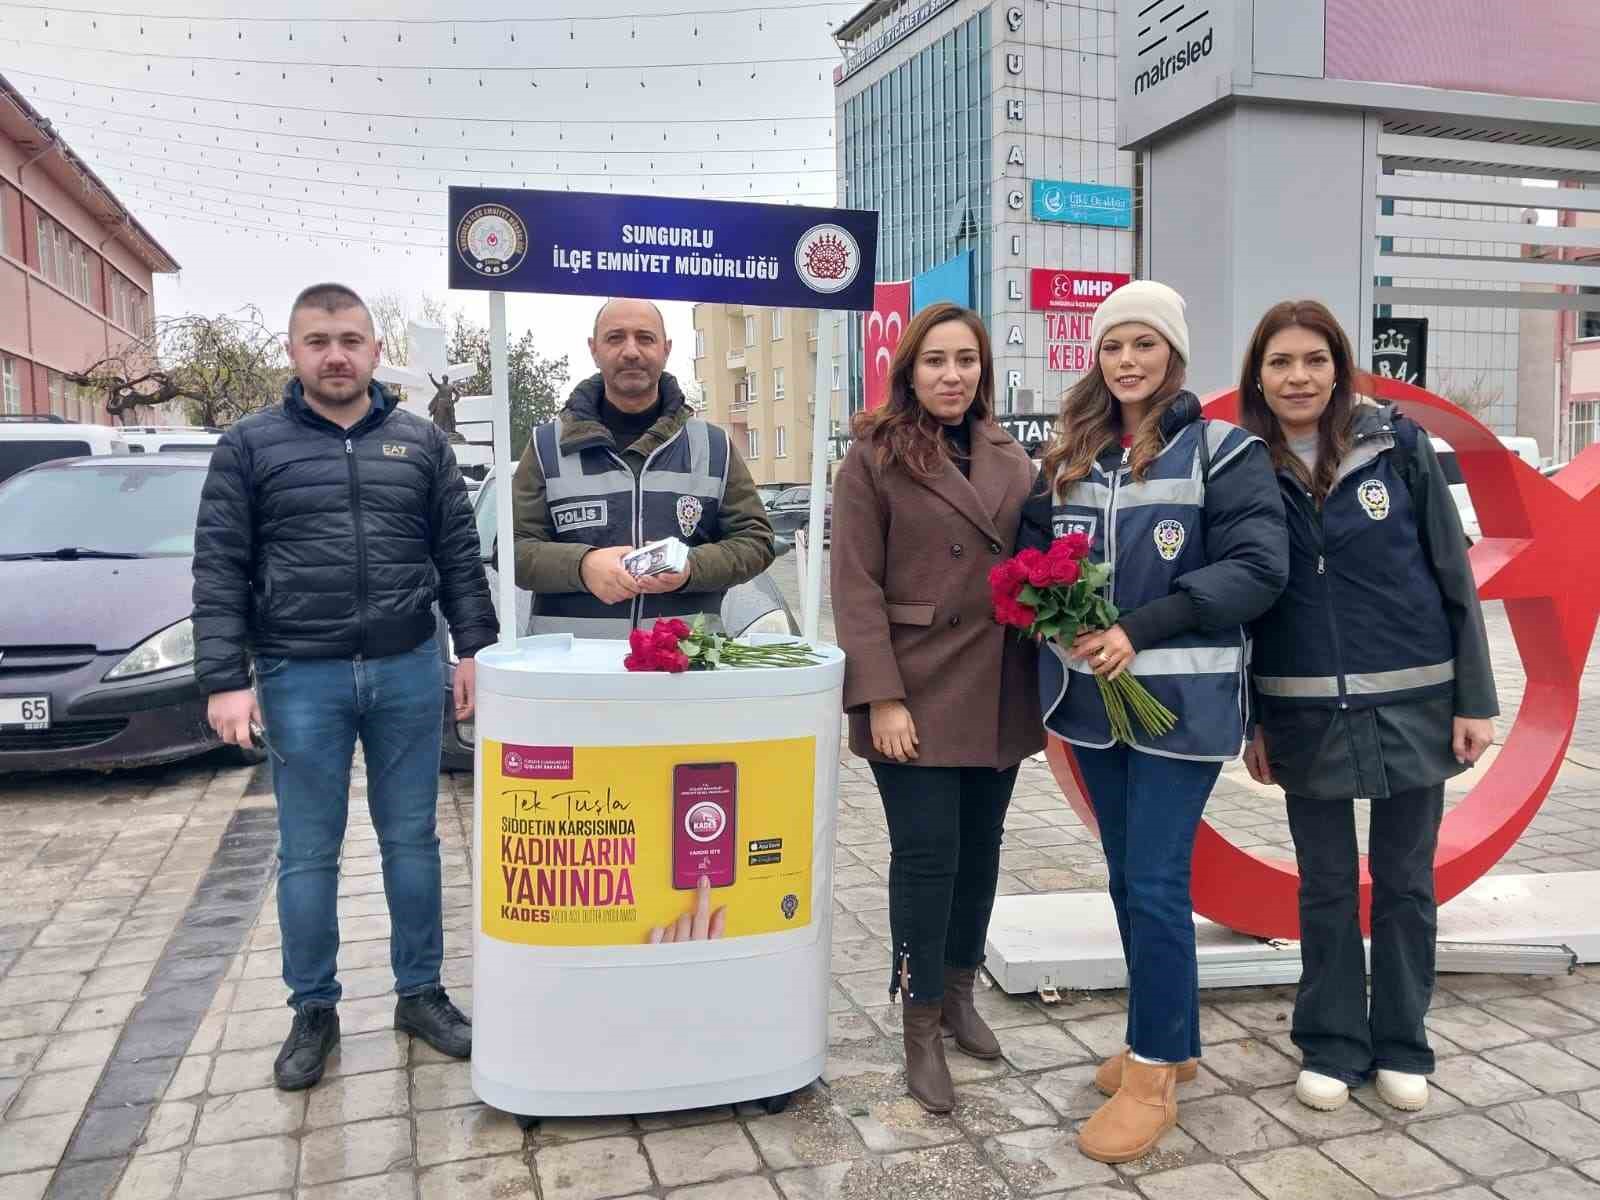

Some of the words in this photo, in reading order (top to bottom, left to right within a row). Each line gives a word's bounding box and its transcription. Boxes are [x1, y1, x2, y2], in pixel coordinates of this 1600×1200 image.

[1134, 27, 1213, 96] matrisled
[622, 224, 714, 249] SUNGURLU
[553, 245, 592, 274] İLÇE
[597, 248, 671, 274] EMNİYET
[675, 252, 779, 280] MÜDÜRLÜĞÜ
[1073, 279, 1113, 297] MHP
[557, 506, 597, 525] POLİS
[22, 700, 47, 721] 65
[501, 788, 547, 817] Tek
[552, 786, 631, 819] Tuşla
[501, 835, 635, 867] KADINLARIN
[501, 865, 635, 907] YANINDA
[501, 905, 551, 923] KADES
